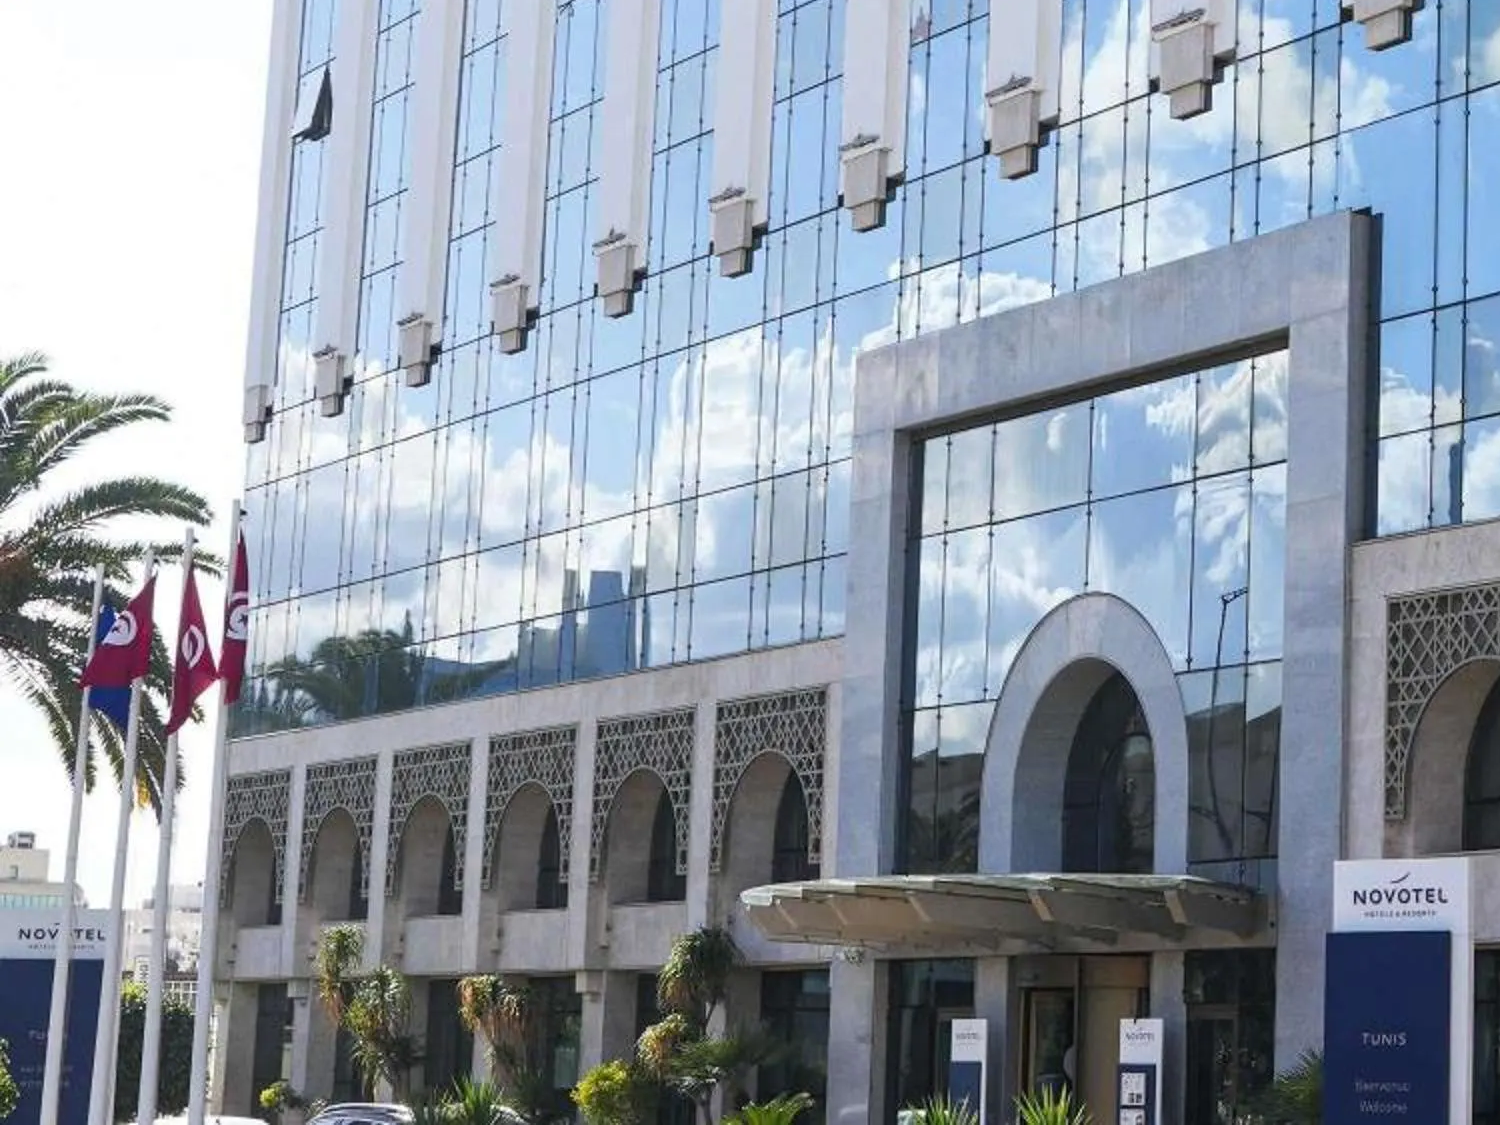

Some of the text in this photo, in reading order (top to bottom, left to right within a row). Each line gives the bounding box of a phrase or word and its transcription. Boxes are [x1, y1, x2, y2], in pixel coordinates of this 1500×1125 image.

[1353, 888, 1449, 905] NOVOTEL
[18, 928, 106, 941] NOVTEL
[1362, 1032, 1407, 1046] TUNIS
